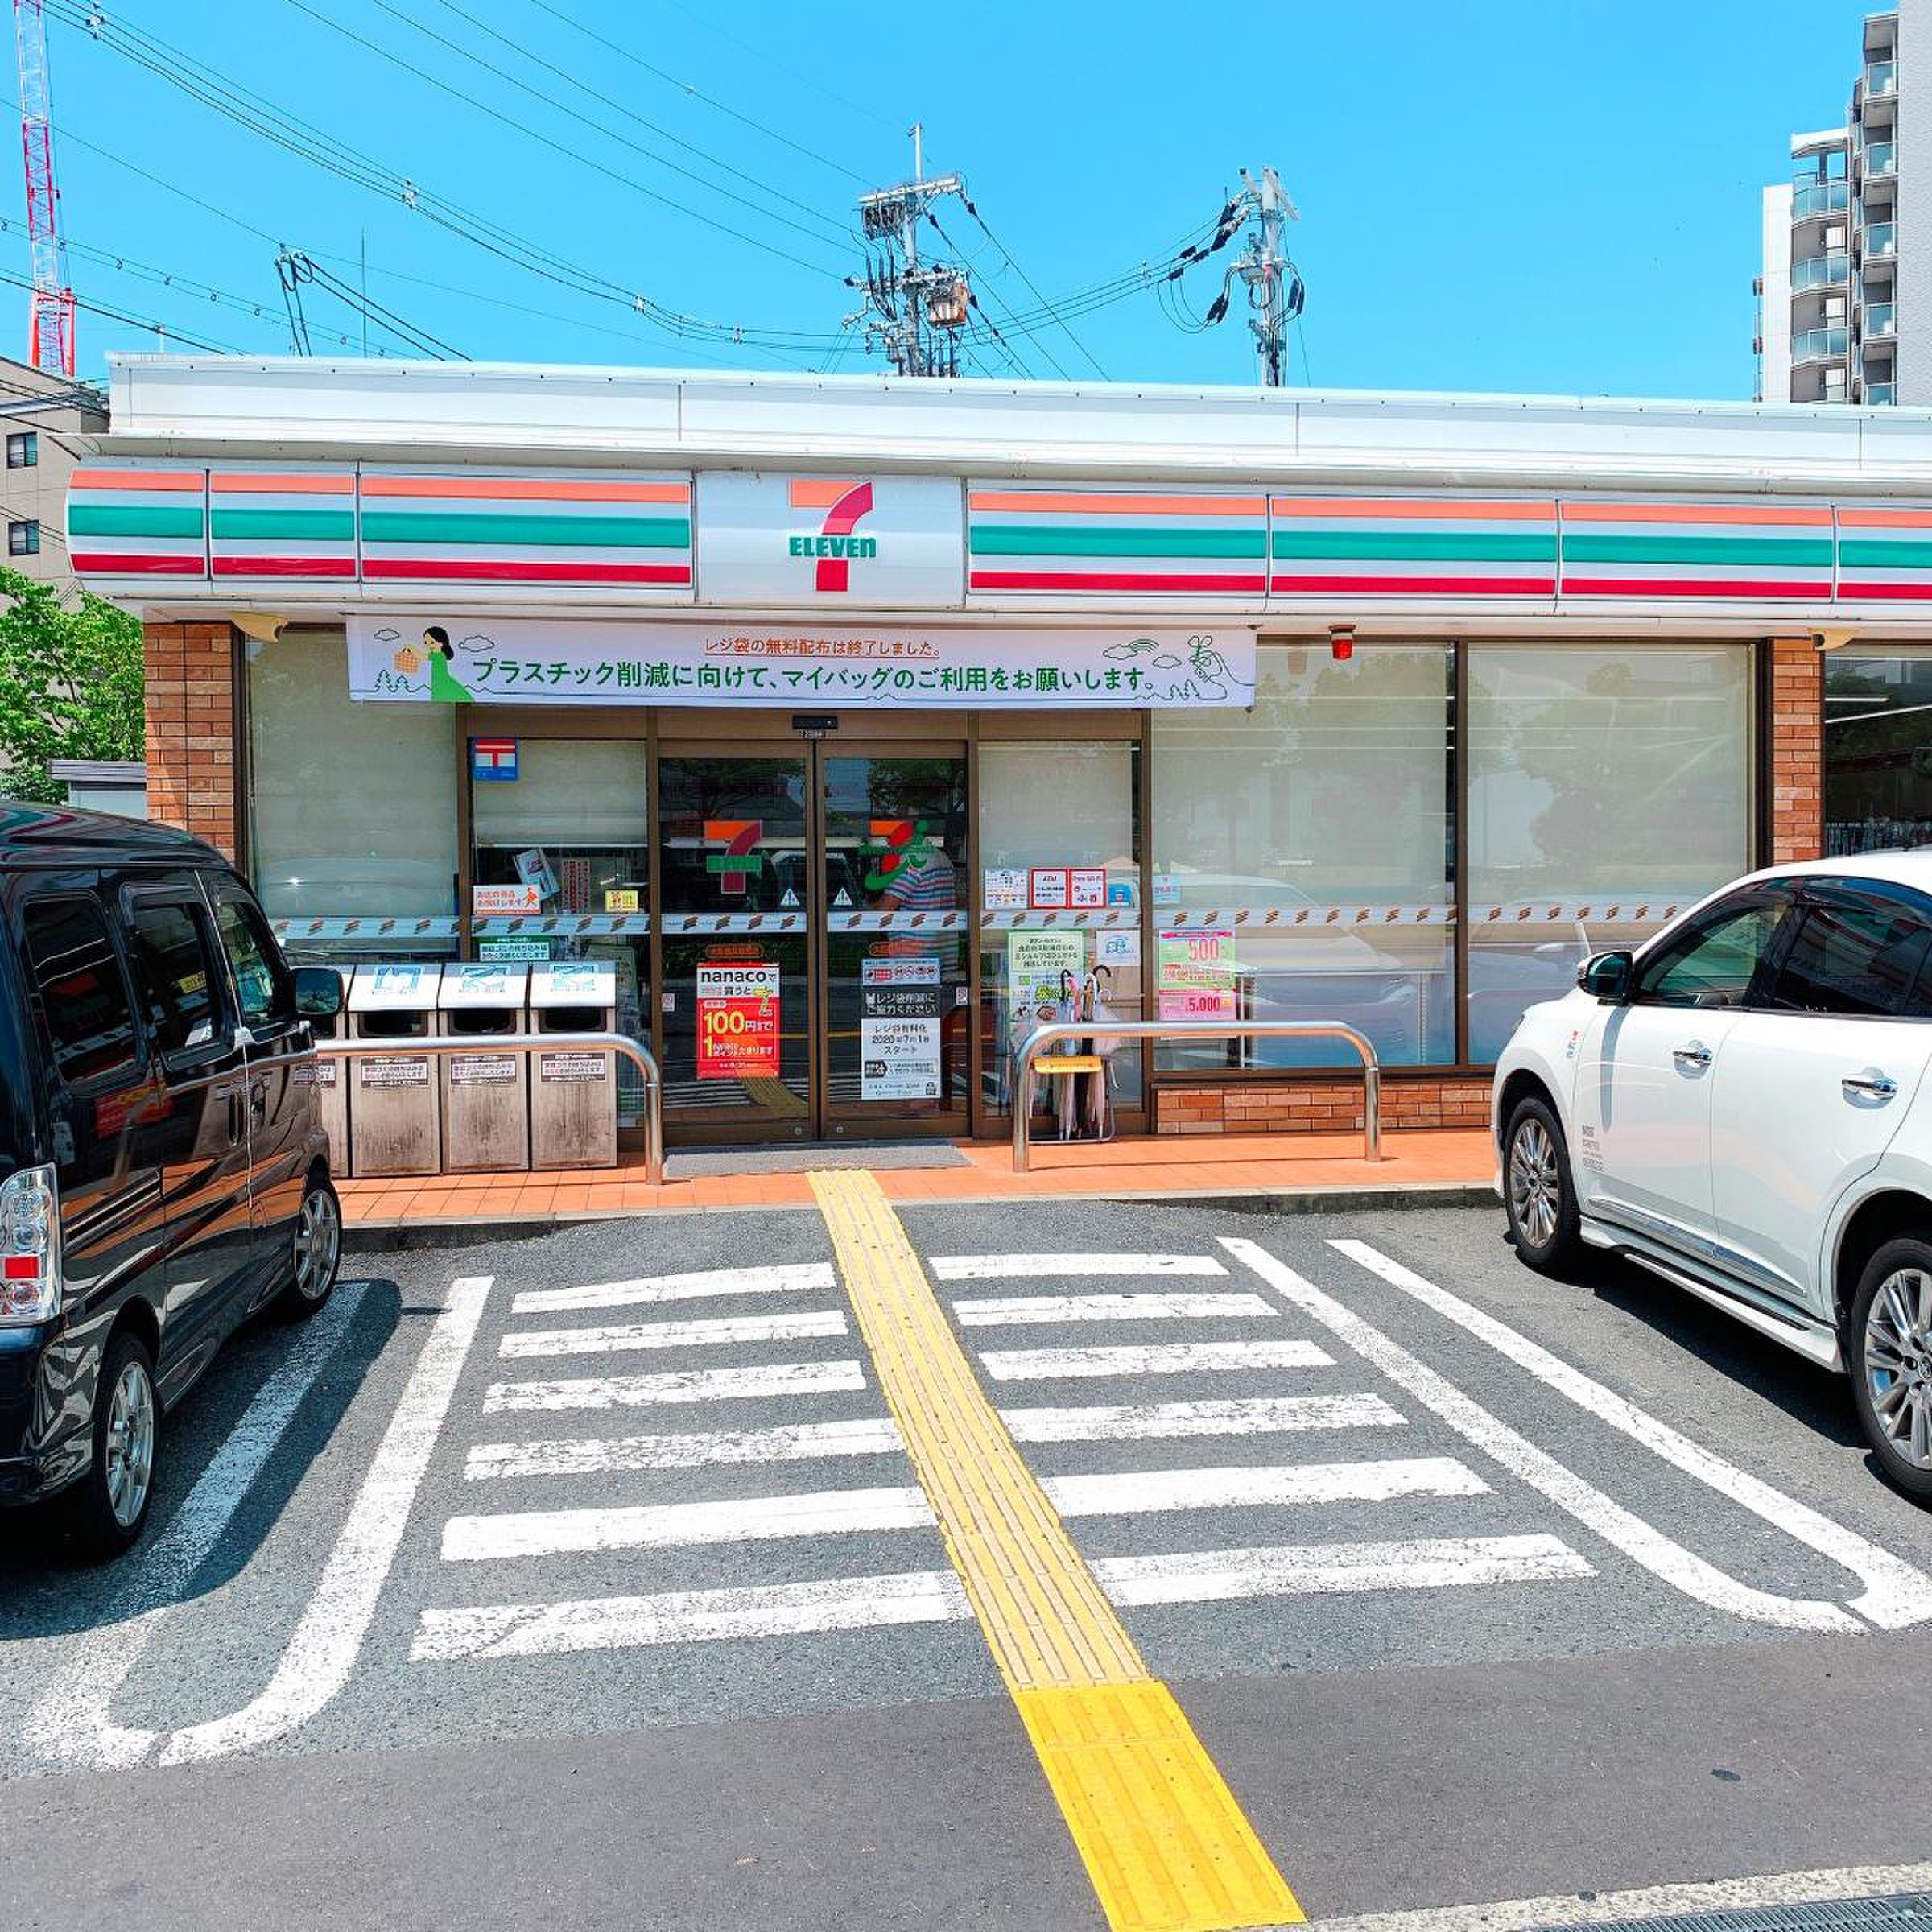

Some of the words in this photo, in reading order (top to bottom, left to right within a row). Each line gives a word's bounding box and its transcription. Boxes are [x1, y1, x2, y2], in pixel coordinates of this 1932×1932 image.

[704, 636, 941, 657] レジ袋の無料配布は終了しました。
[473, 657, 1154, 692] プラスチック削減に向けて、マイバッグのご利用をお願いします。
[884, 1046, 917, 1055] スタート
